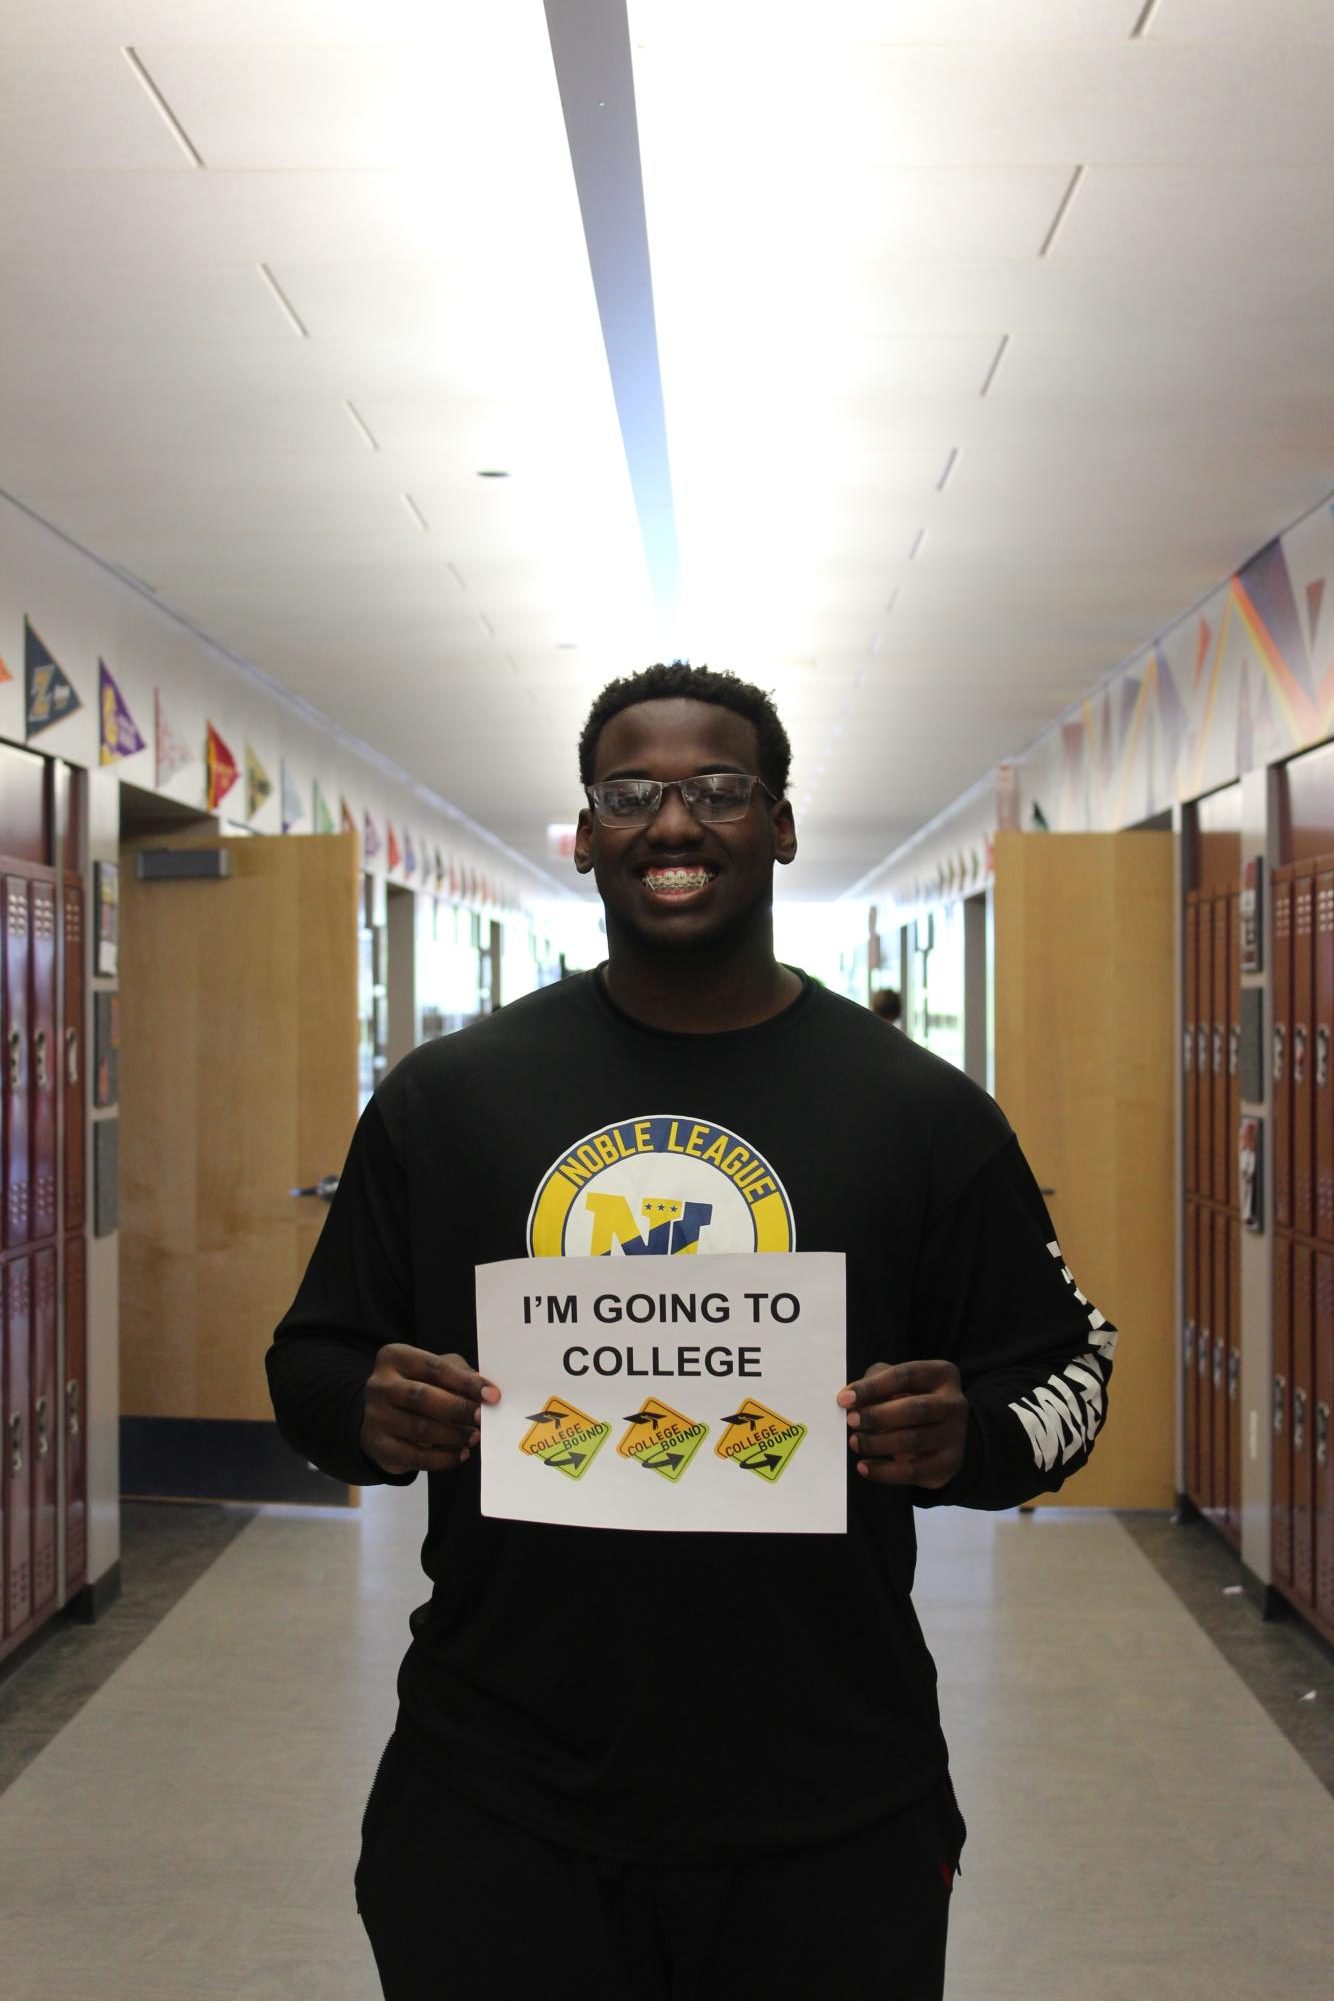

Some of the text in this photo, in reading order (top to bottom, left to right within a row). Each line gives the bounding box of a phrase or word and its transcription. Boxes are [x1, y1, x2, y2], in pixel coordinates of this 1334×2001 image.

[560, 1121, 778, 1203] NOBLE LEAGUE
[593, 1293, 730, 1324] GOING
[744, 1293, 801, 1324] TO
[562, 1346, 762, 1377] COLLEGE
[529, 1423, 582, 1453] COLLEGE
[562, 1422, 604, 1450] BOUND
[627, 1424, 680, 1455] COLLEGE
[660, 1424, 702, 1451] BOUND
[725, 1425, 778, 1456] COLLEGE
[758, 1424, 800, 1451] BOUND
